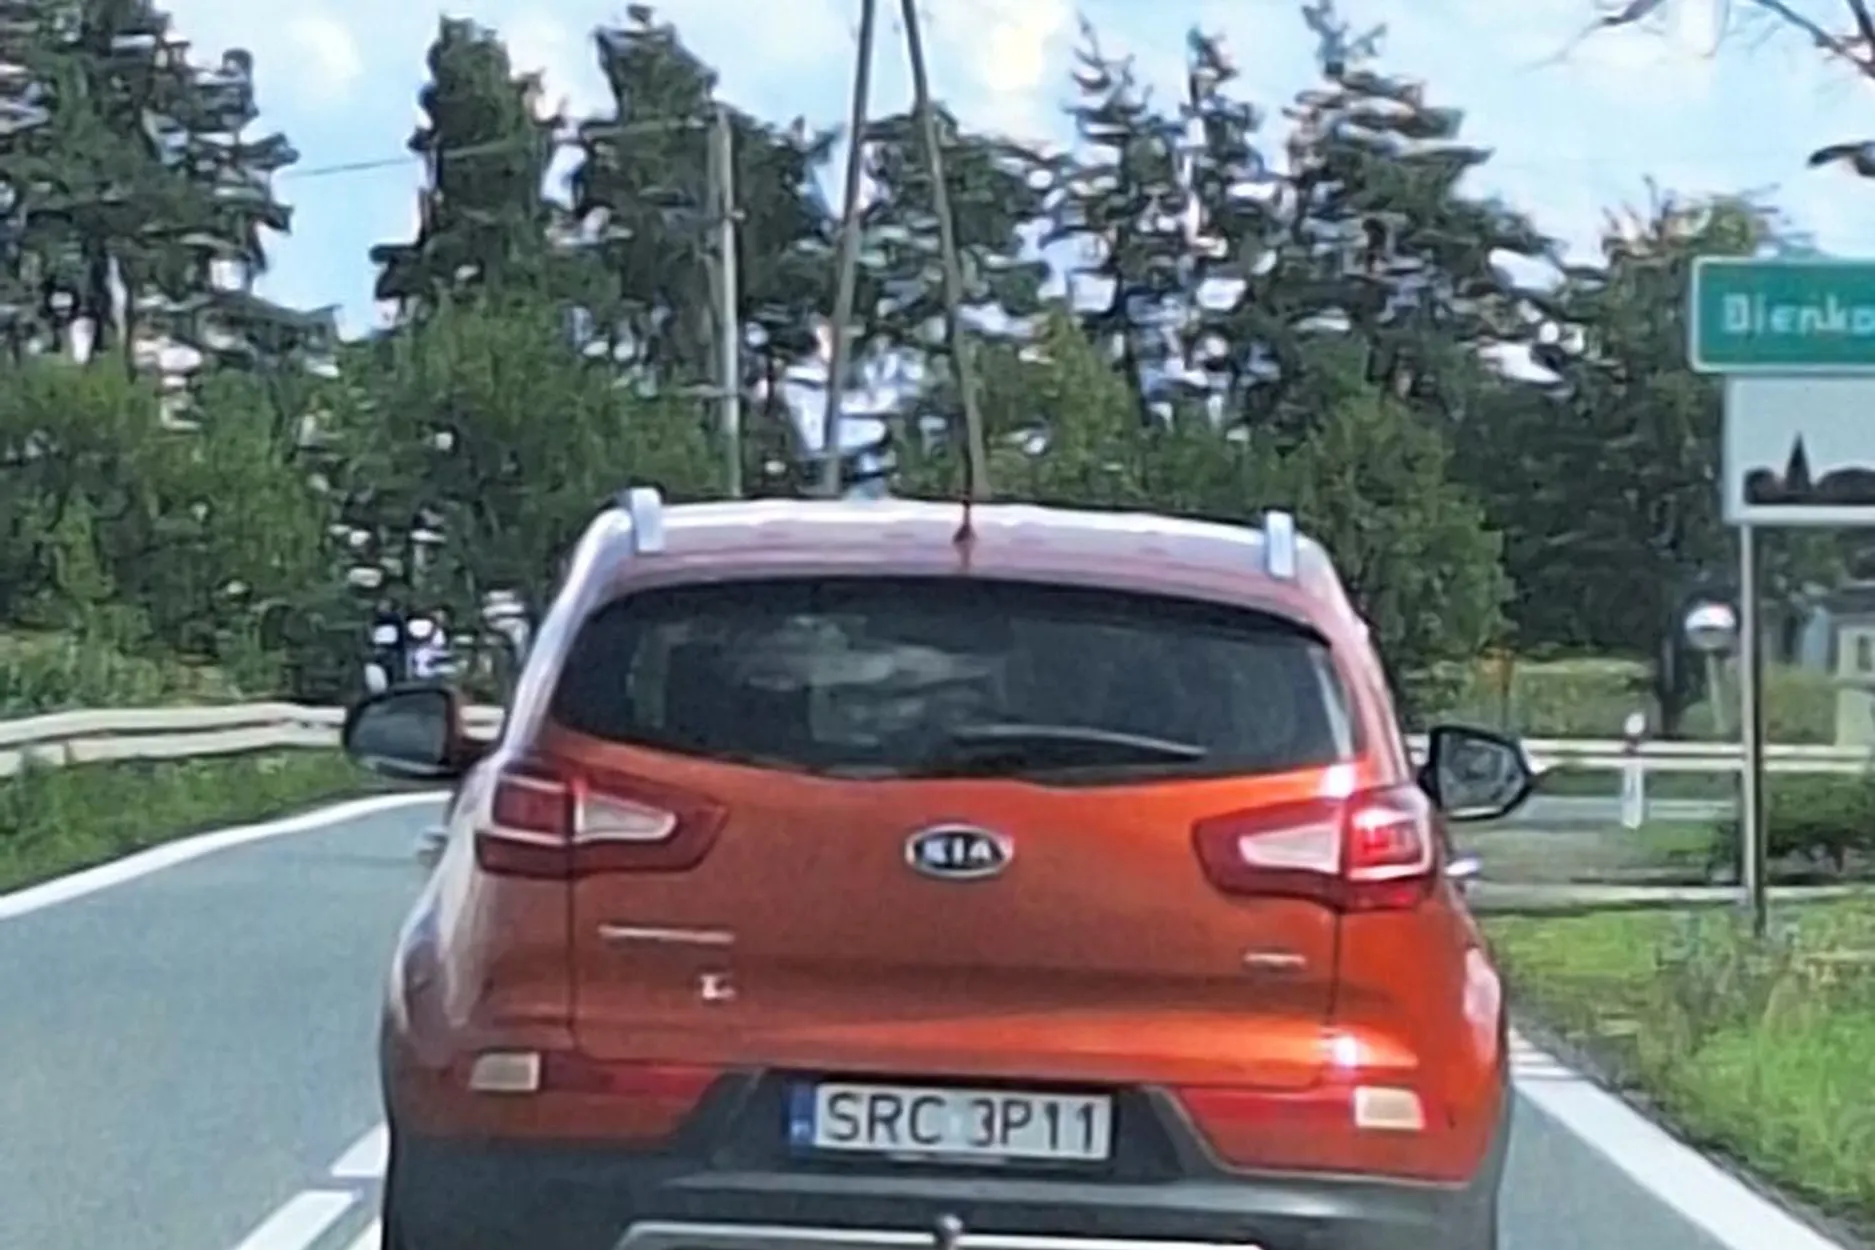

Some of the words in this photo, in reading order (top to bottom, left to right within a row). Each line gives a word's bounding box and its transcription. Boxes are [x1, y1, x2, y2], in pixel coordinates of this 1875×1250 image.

[922, 836, 995, 864] KIA
[826, 1092, 946, 1146] SRC
[969, 1098, 1095, 1153] 3P11
